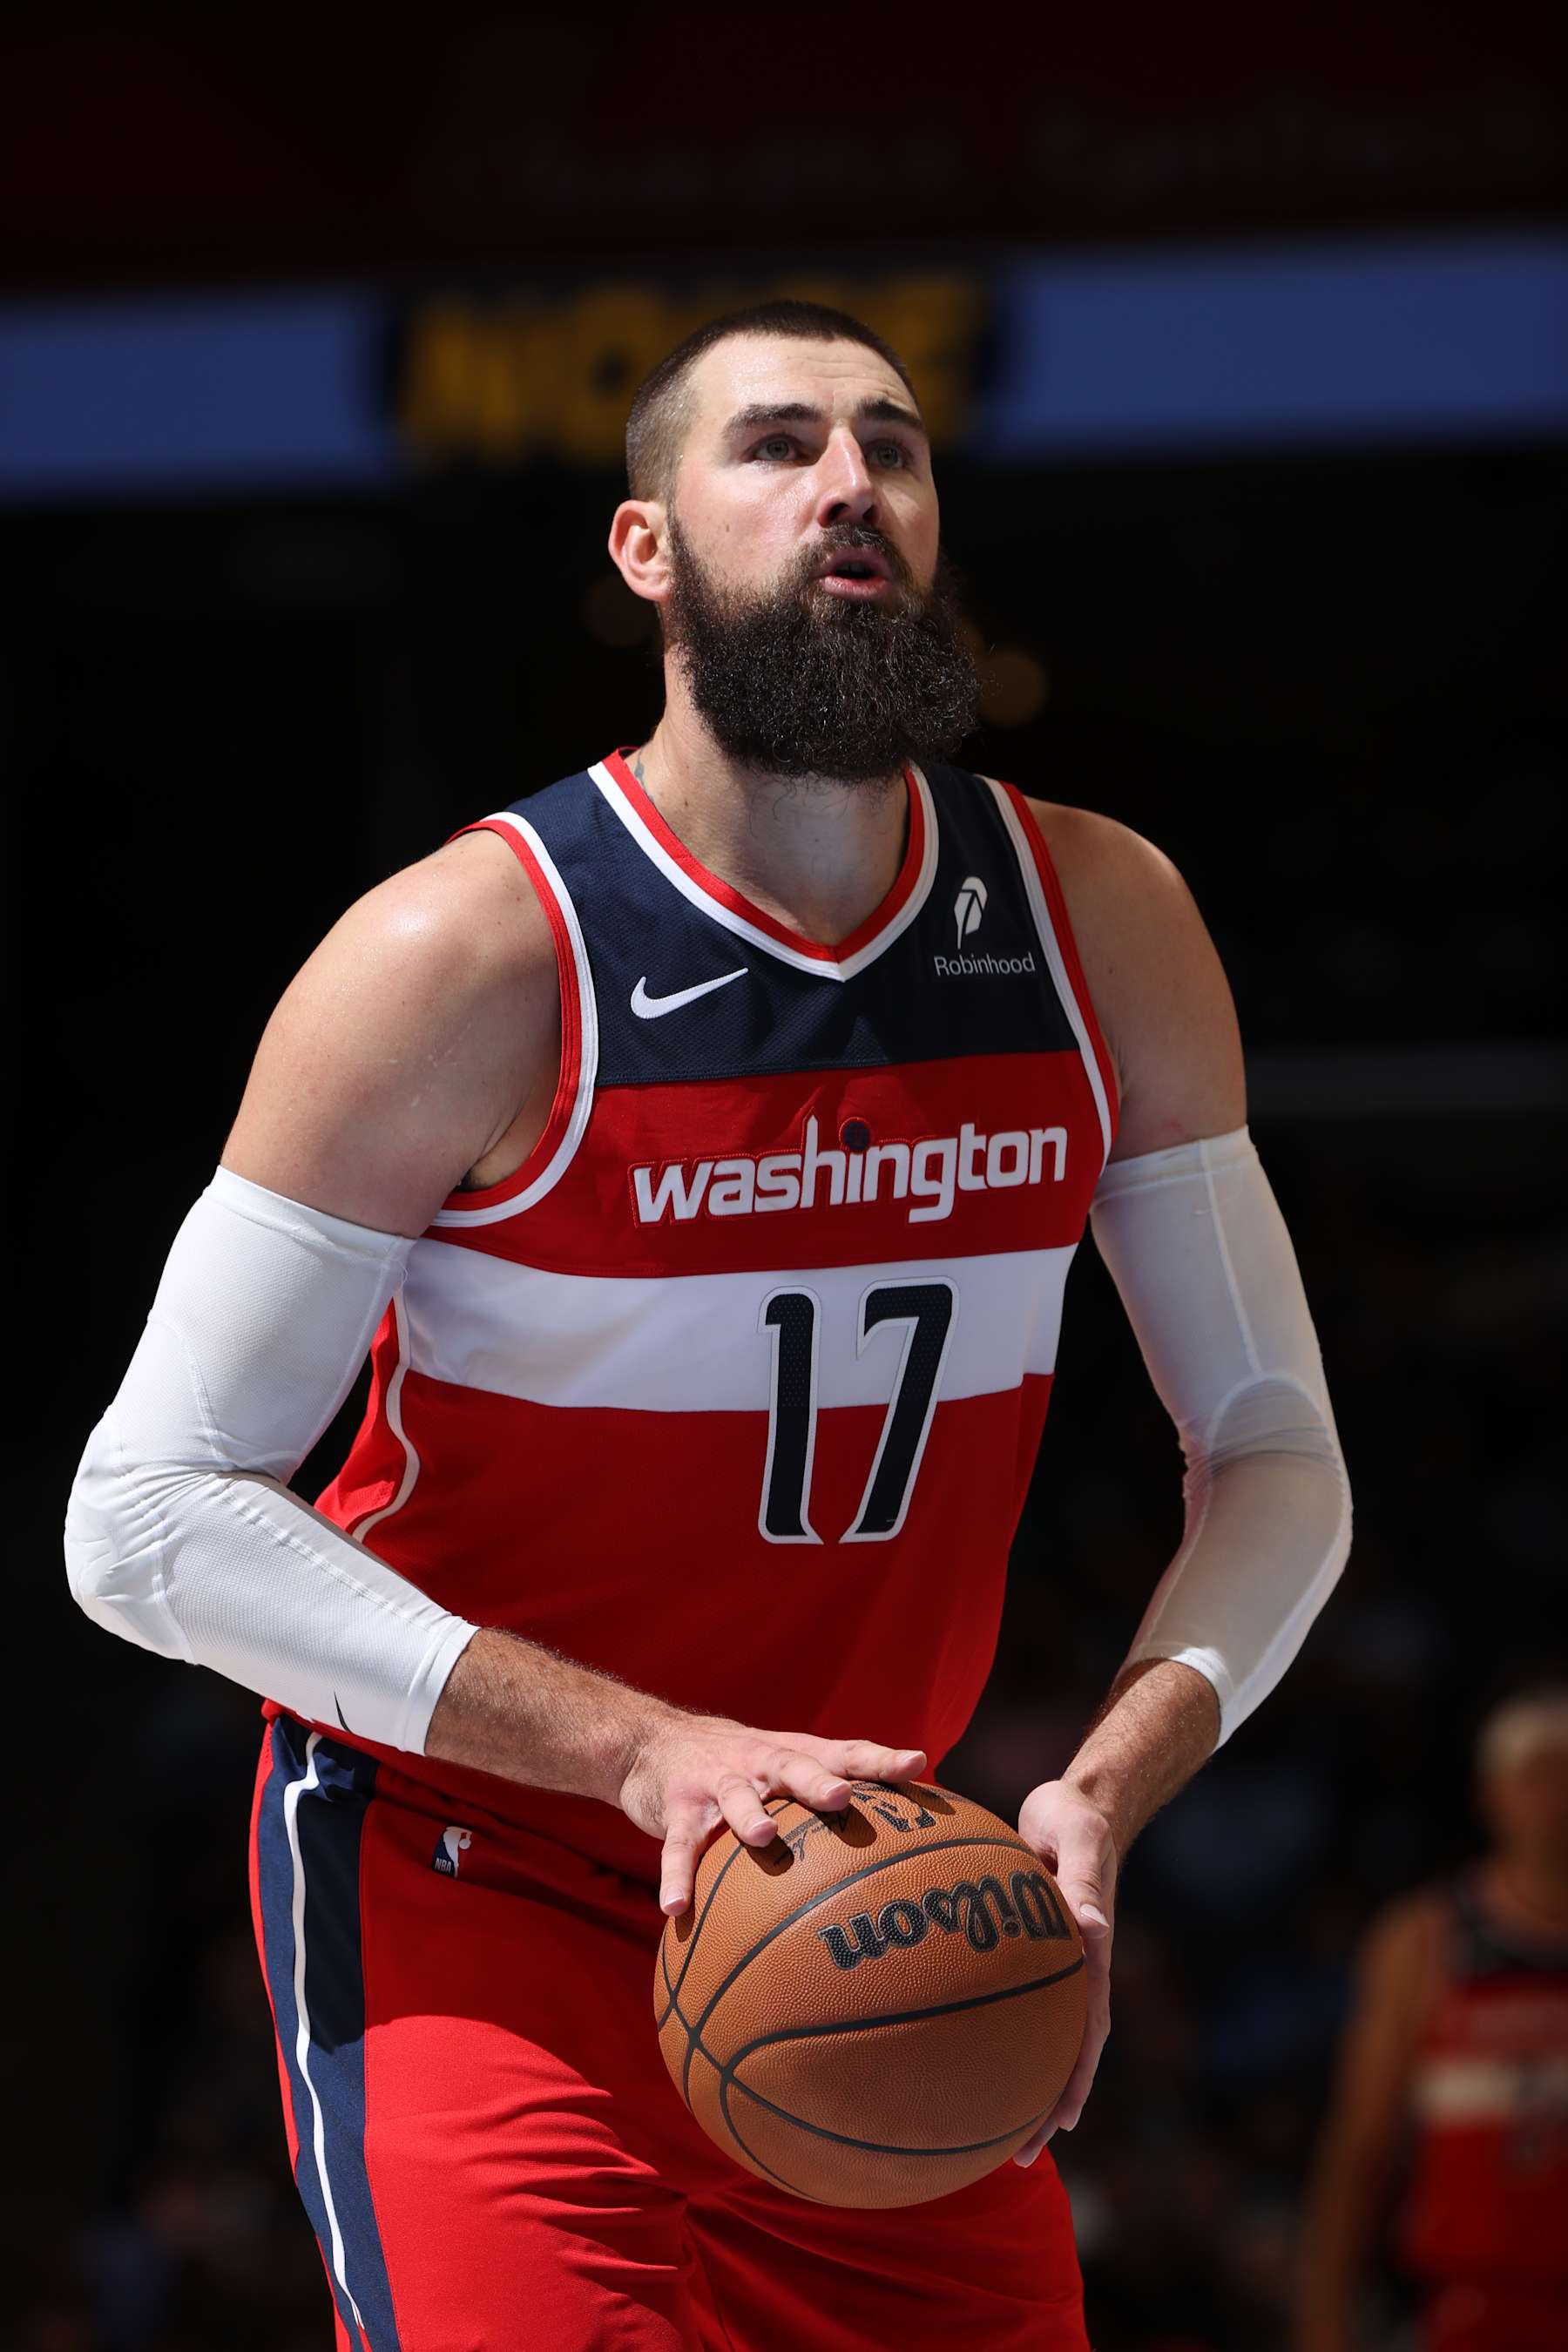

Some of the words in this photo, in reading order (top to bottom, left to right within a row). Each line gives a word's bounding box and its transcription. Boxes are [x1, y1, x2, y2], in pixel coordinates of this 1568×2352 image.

[933, 951, 1037, 977] Robinhood
[632, 1114, 1069, 1224] washington
[756, 1275, 958, 1545] 17
[434, 1856, 452, 1875] NBA
[817, 1870, 1073, 1971] Wilson
